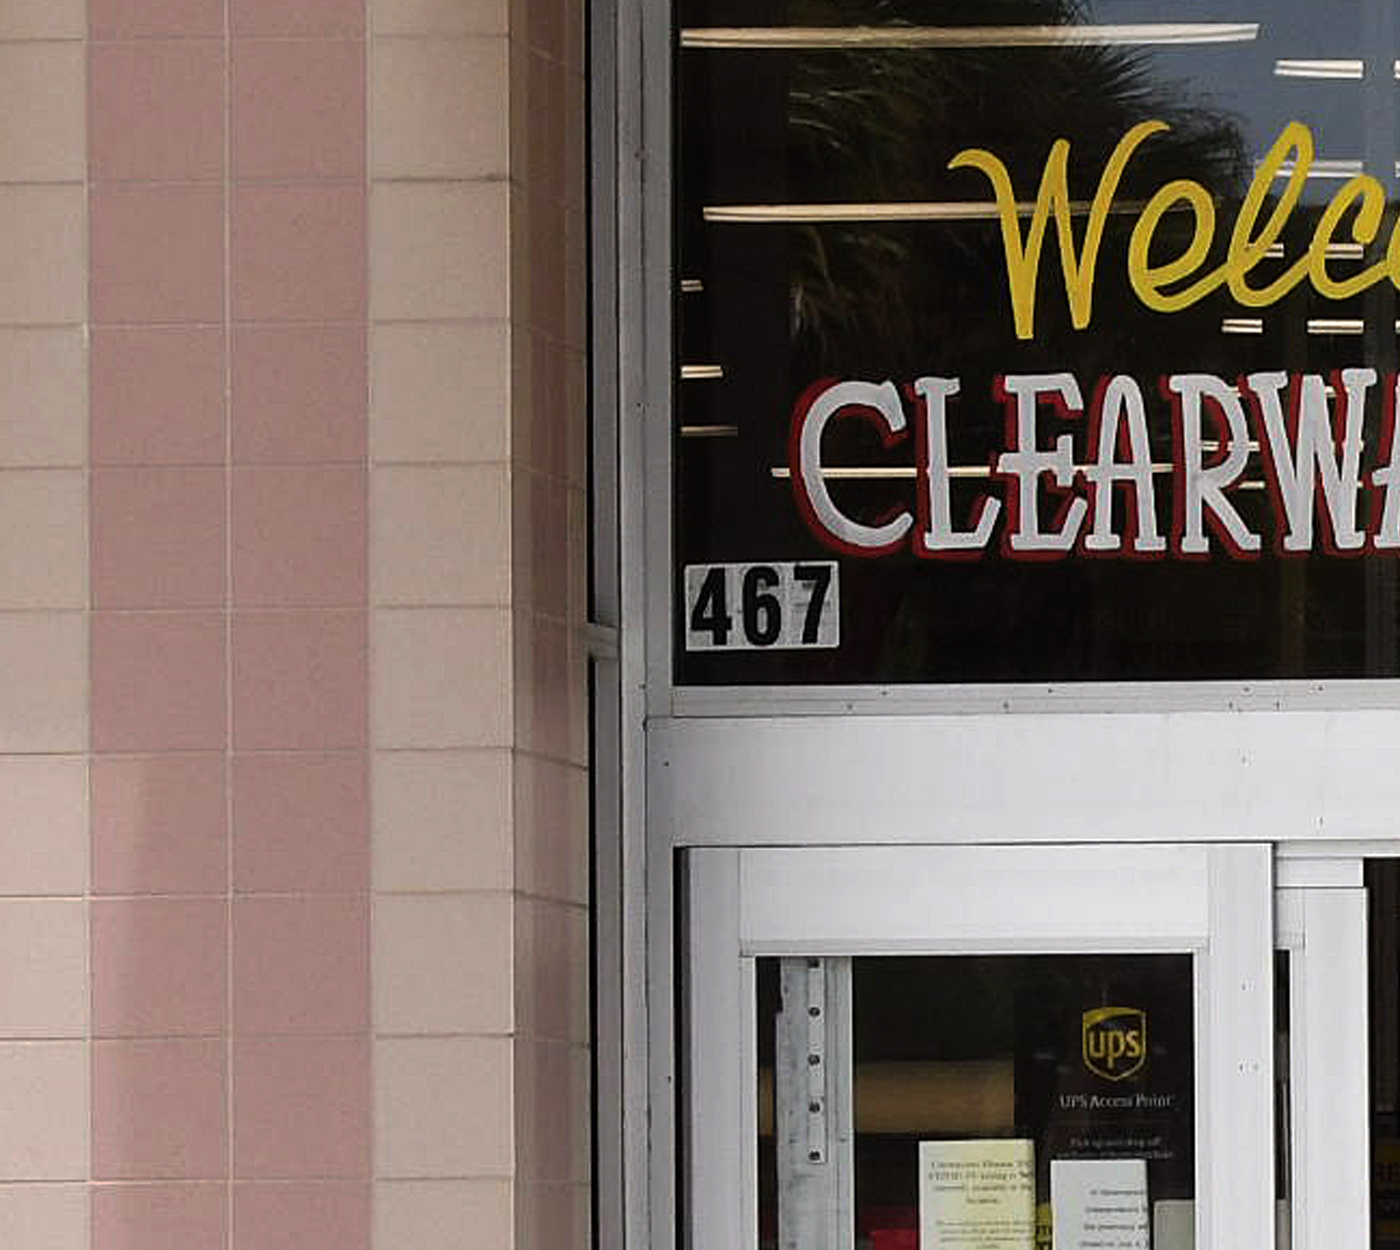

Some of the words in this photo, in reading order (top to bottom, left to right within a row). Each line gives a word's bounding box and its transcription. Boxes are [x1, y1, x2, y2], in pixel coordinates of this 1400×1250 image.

[690, 565, 834, 649] 467
[1088, 1029, 1142, 1070] ups
[1060, 1095, 1088, 1108] UPS
[1089, 1095, 1133, 1108] Access
